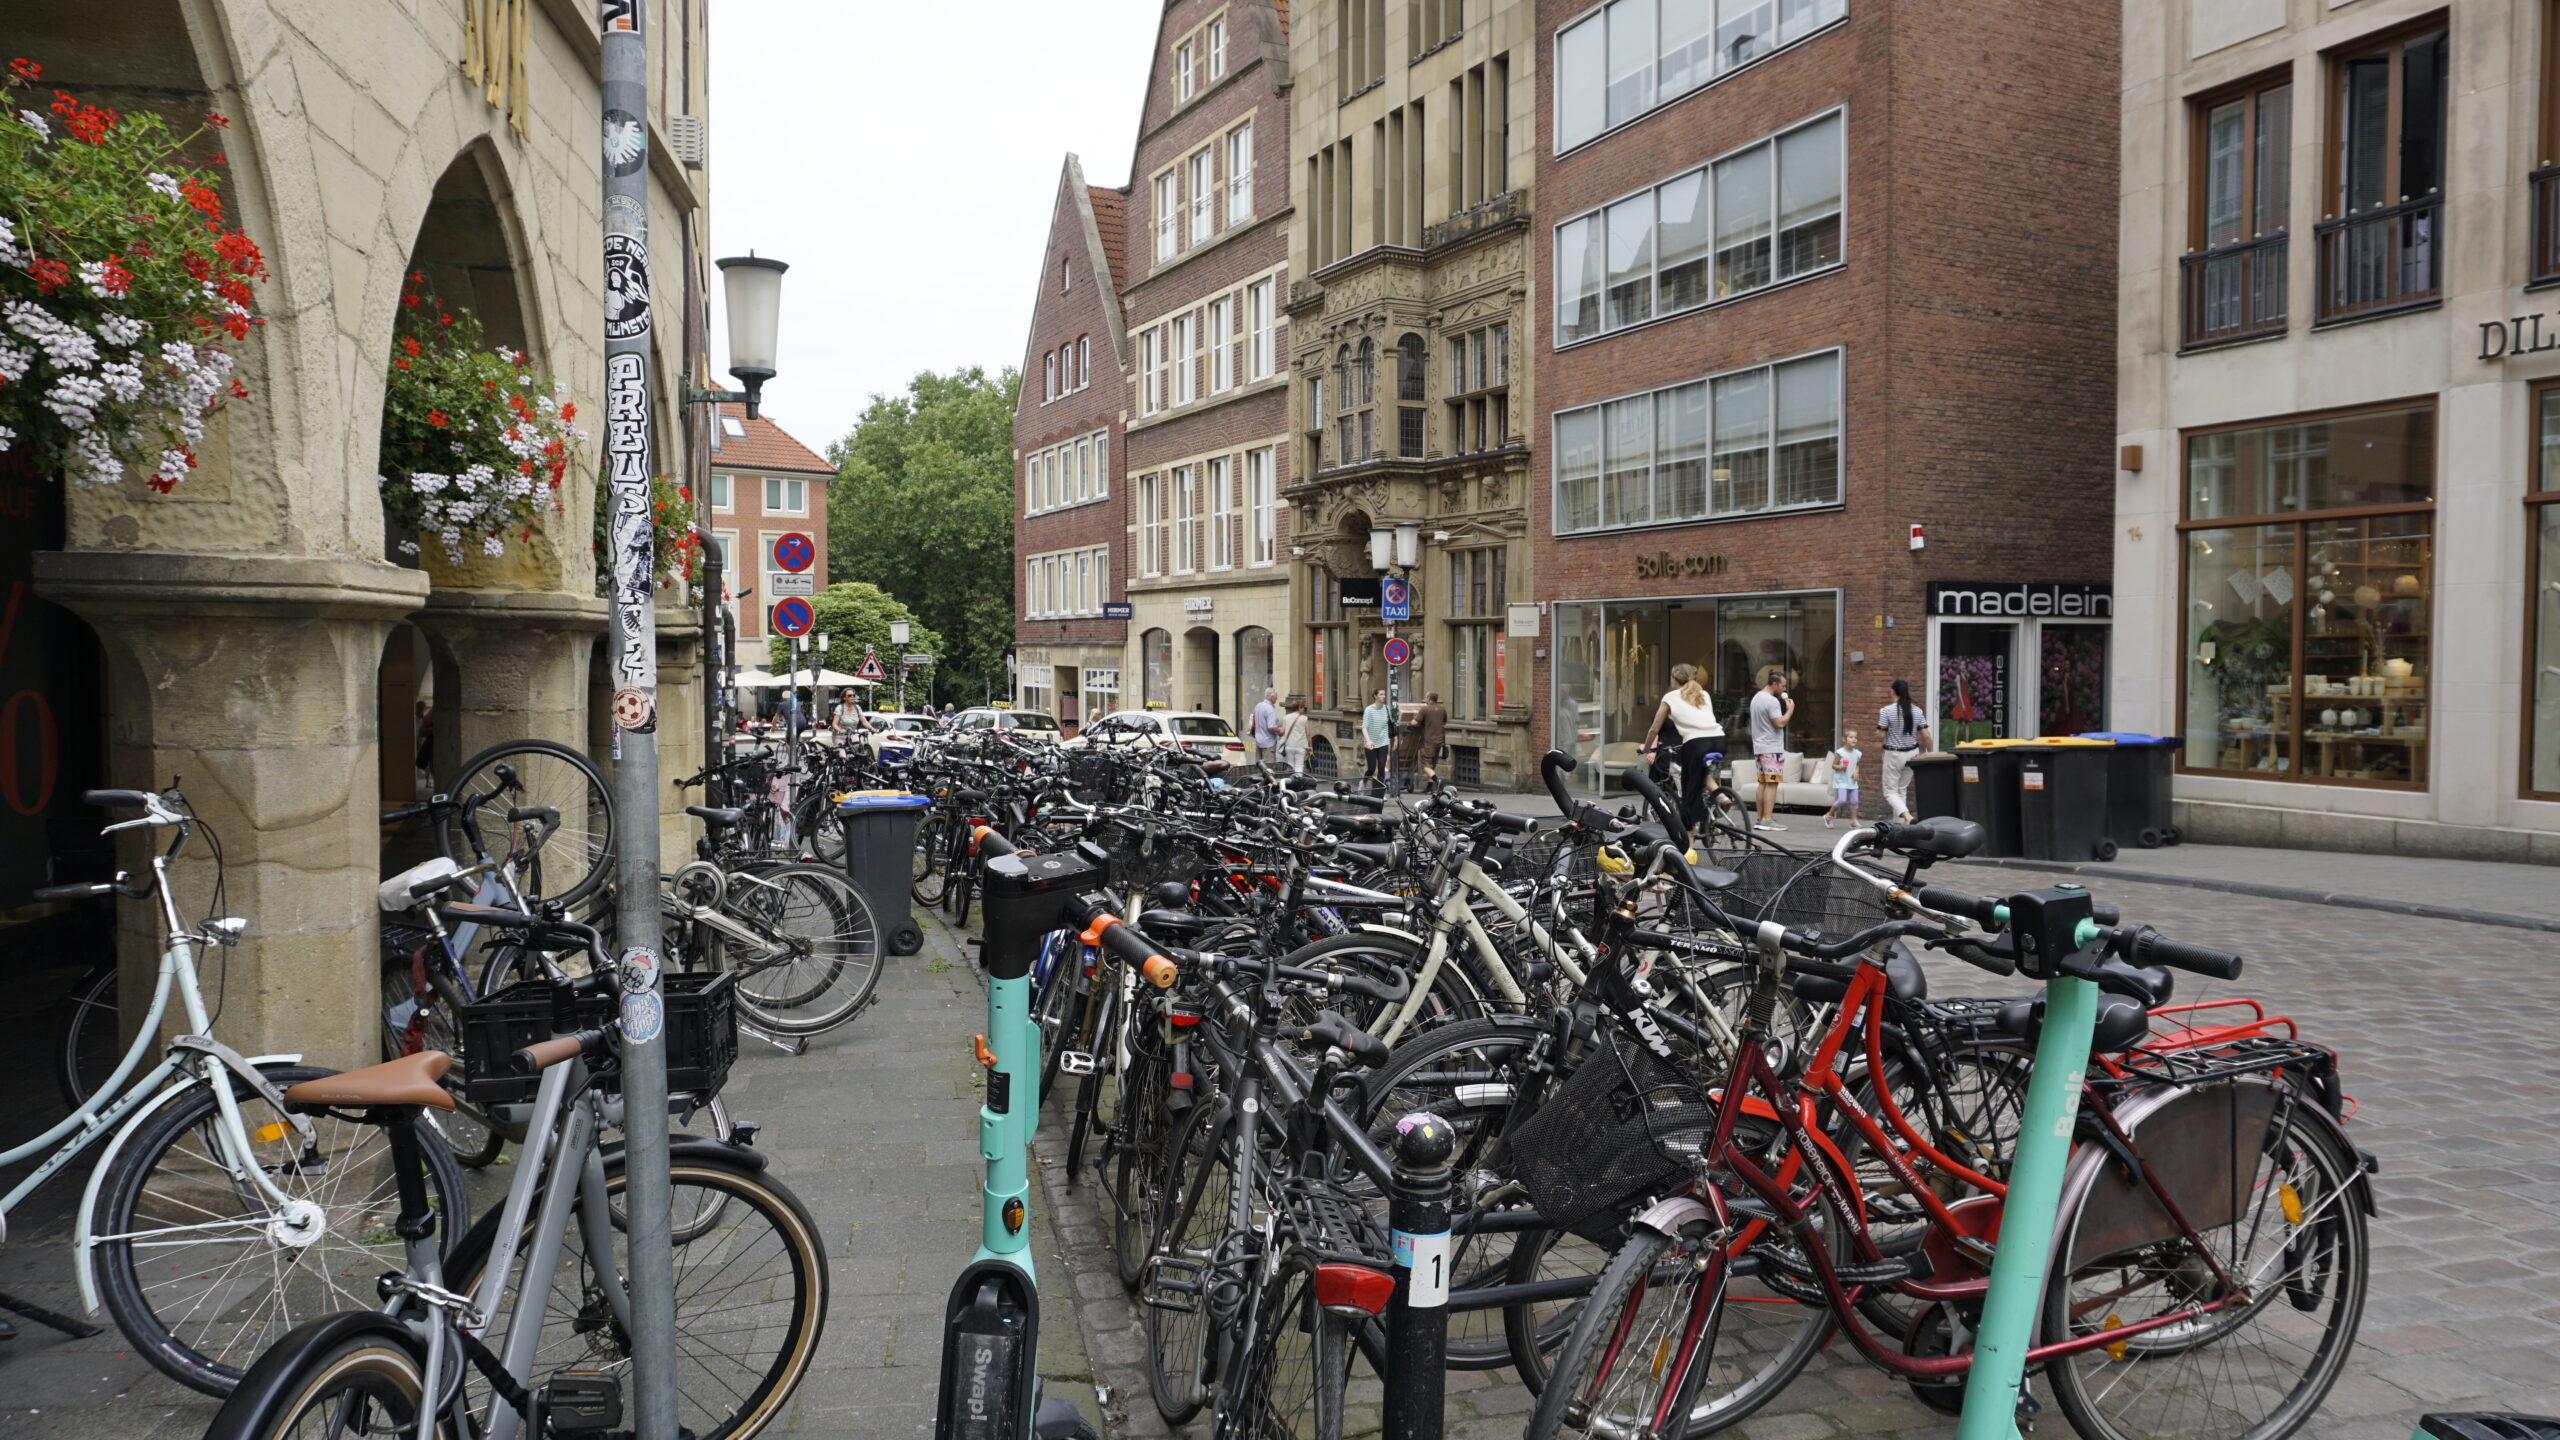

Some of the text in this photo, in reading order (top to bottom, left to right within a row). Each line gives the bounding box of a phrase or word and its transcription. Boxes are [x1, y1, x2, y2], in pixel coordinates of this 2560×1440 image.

[2478, 312, 2560, 360] DIL
[1342, 596, 1374, 605] BoConcept
[1385, 606, 1407, 616] TAXI
[1627, 1008, 1671, 1058] KTM
[2054, 1070, 2087, 1137] Bolt
[38, 1094, 135, 1174] GAZELLE
[1431, 1254, 1441, 1289] 1
[967, 1348, 993, 1422] Swap!
